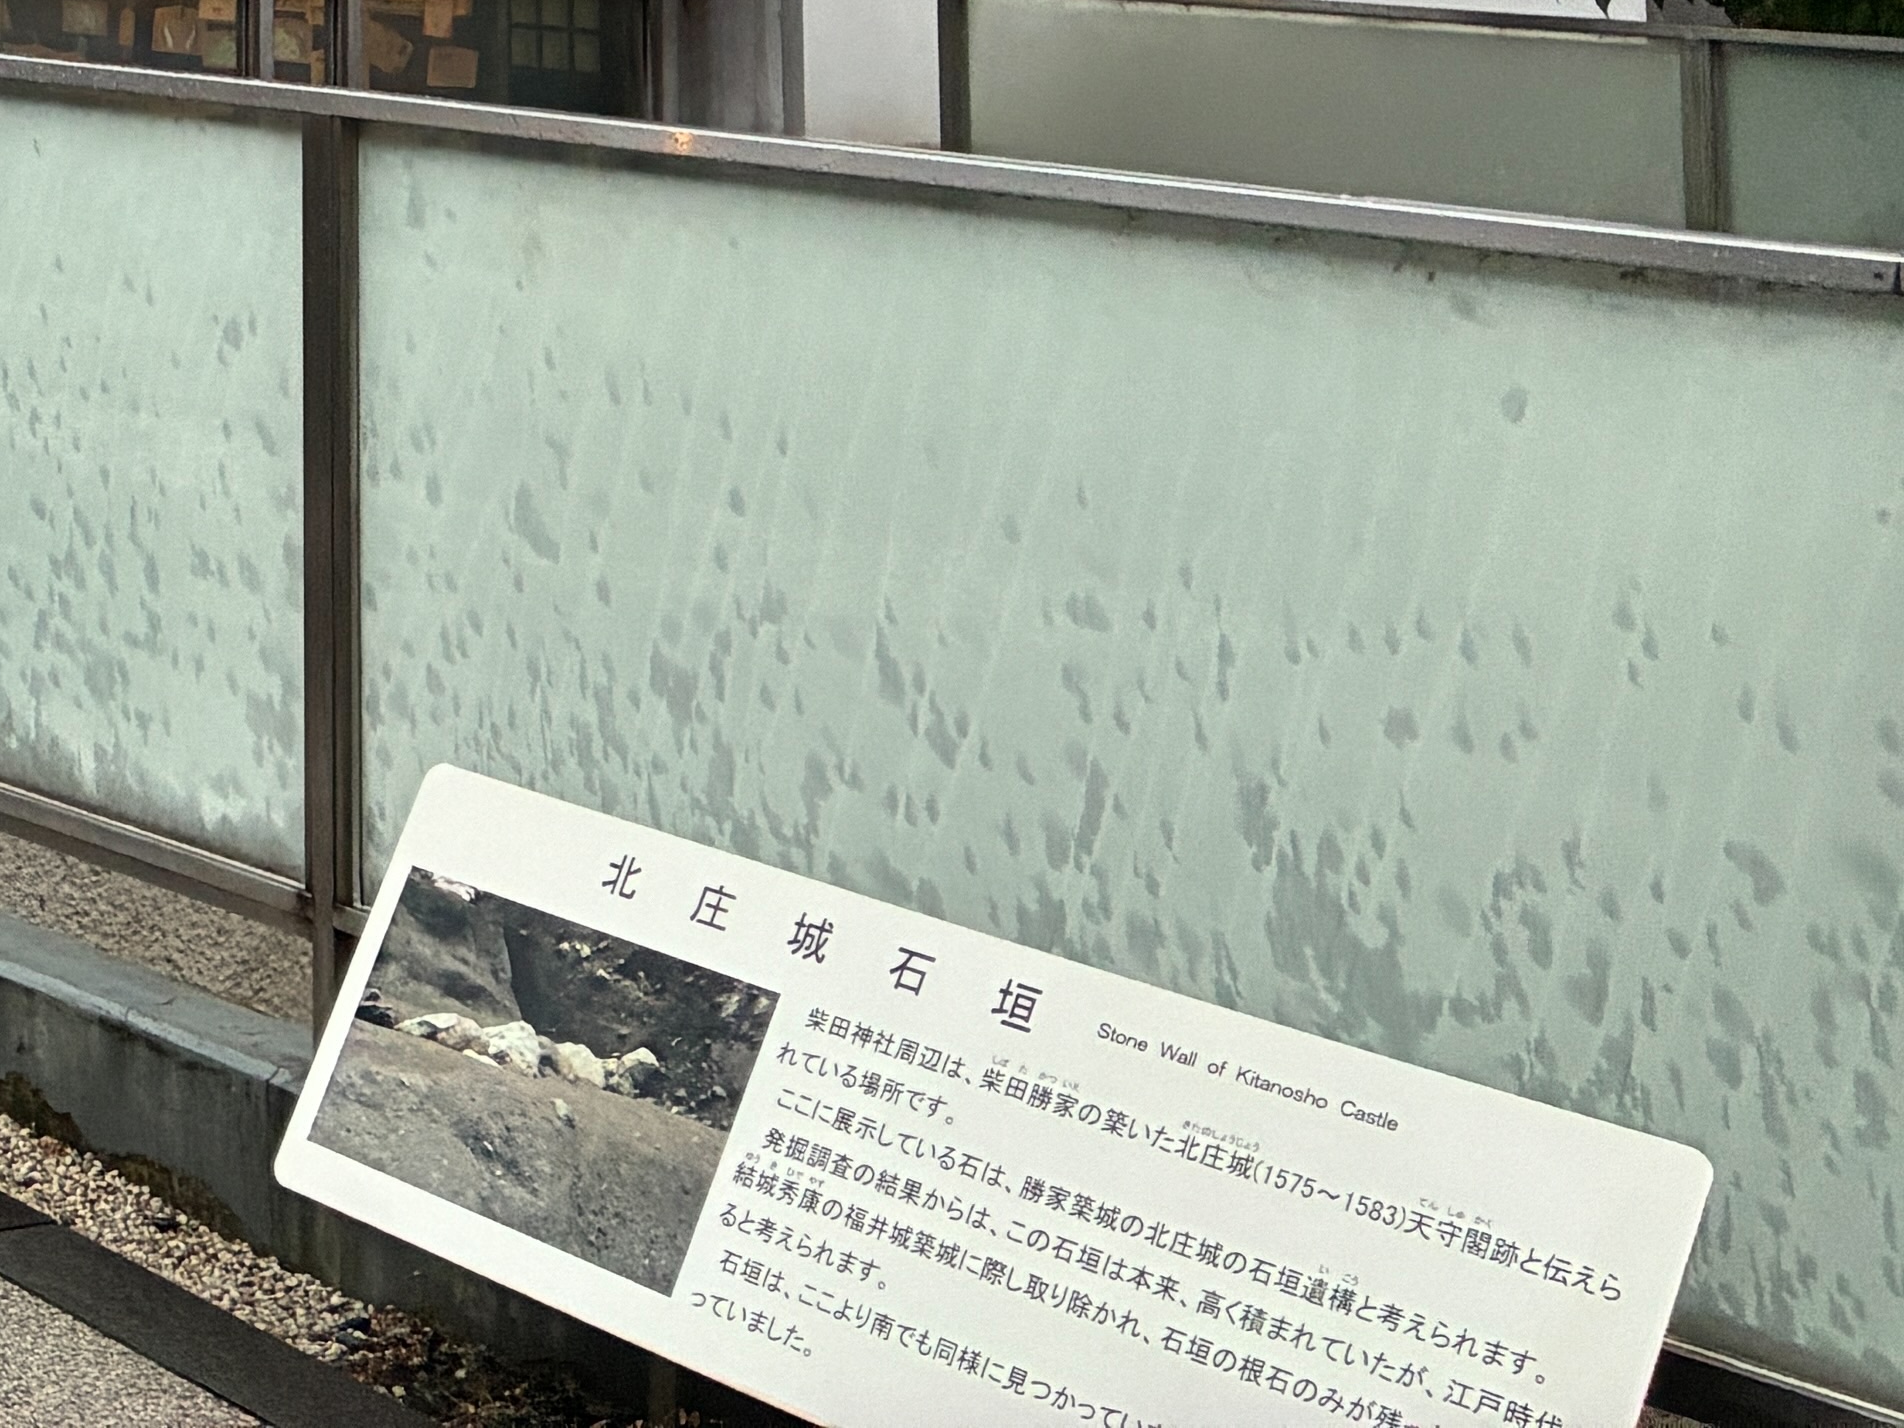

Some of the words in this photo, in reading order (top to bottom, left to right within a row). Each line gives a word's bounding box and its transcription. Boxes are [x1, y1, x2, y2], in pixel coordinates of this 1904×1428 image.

[601, 853, 1044, 1034] 北庄城石垣
[776, 1041, 956, 1126] れている場所です。
[1096, 1022, 1149, 1053] Stone
[1160, 1041, 1198, 1069] Wall
[1207, 1058, 1228, 1076] of
[1235, 1066, 1329, 1110] Kitanosho
[1340, 1099, 1400, 1132] Castle
[719, 1202, 887, 1290] ると考えられます。
[732, 1160, 1442, 1428] 結城秀康の福井城築城に際し取り除かれ、石垣の根石のみが残
[690, 1290, 812, 1358] っていました。
[719, 1249, 1162, 1428] 石垣は、ここより南でも同様に見つかってい
